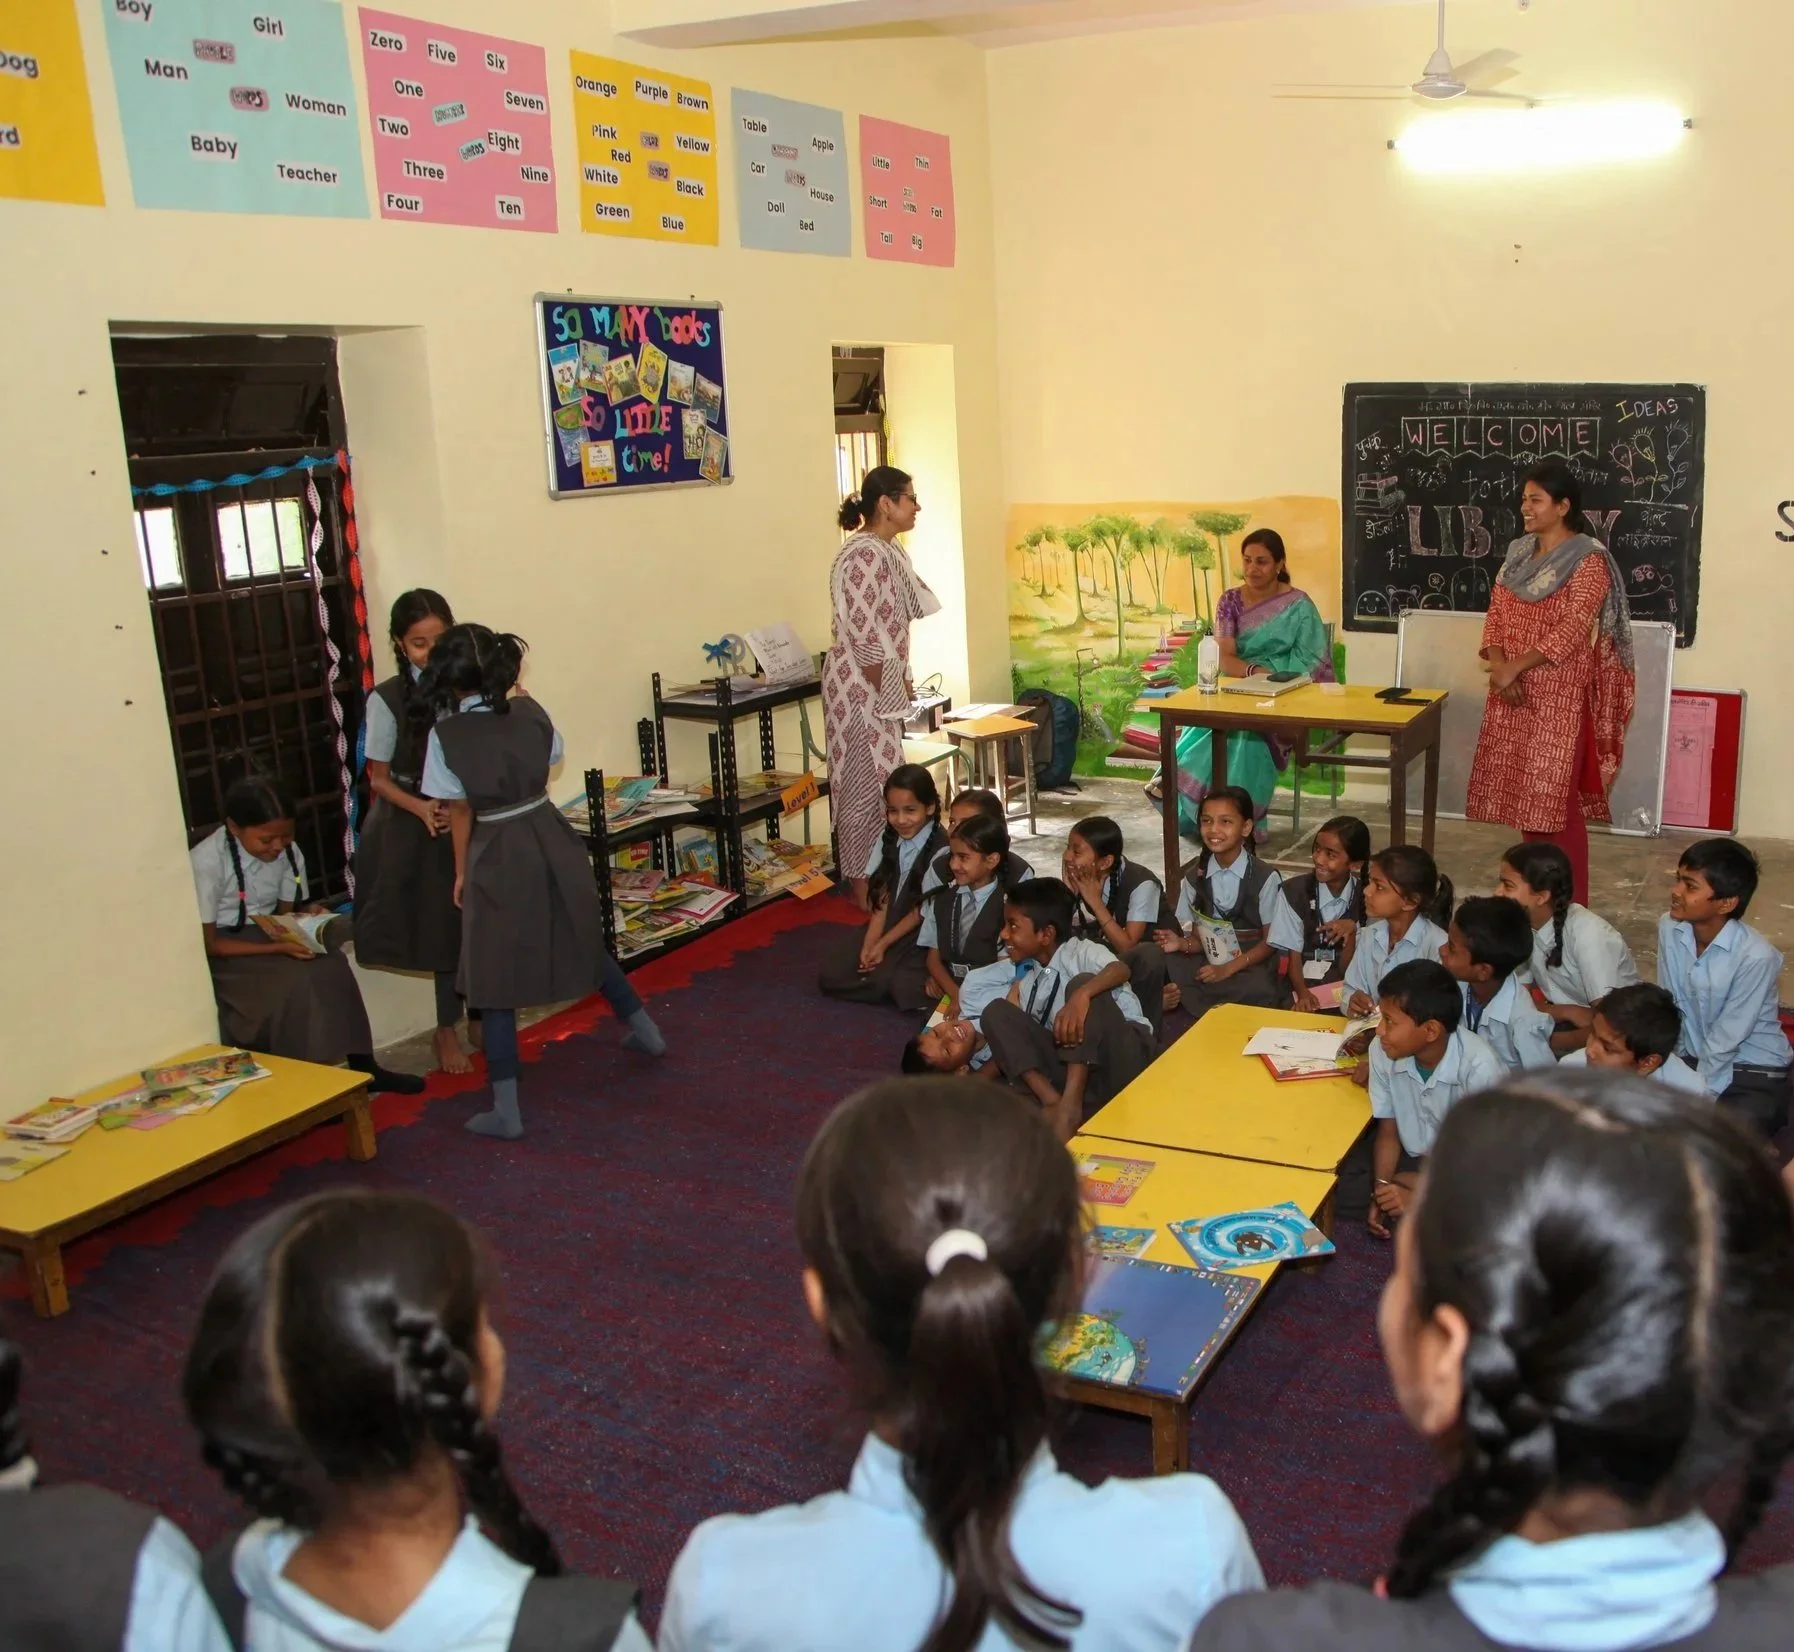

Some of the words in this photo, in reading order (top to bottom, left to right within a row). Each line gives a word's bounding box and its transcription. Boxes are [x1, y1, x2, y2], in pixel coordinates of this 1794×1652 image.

[115, 0, 152, 22] Boy
[253, 16, 283, 36] Girl
[370, 31, 403, 51] Zero
[427, 43, 456, 63] Five
[486, 53, 505, 71] Six
[144, 59, 189, 80] Man
[394, 80, 424, 97] One
[575, 75, 617, 98] Orange
[635, 80, 669, 101] Purple
[285, 93, 347, 116] Woman
[505, 91, 544, 111] Seven
[677, 92, 709, 110] Brown
[378, 118, 409, 136] Two
[592, 124, 617, 140] Pink
[742, 118, 767, 133] Table
[190, 135, 238, 160] Baby
[487, 131, 520, 152] Eight
[676, 135, 710, 152] Yellow
[812, 137, 834, 153] Apple
[610, 148, 632, 163] Red
[872, 156, 890, 170] Little
[915, 157, 930, 169] Thin
[277, 164, 338, 183] Teacher
[403, 160, 445, 180] Three
[520, 166, 549, 182] Nine
[584, 167, 619, 185] White
[750, 161, 766, 174] Car
[676, 180, 704, 197] Black
[810, 188, 835, 203] House
[387, 194, 420, 211] Four
[498, 200, 521, 215] Ten
[595, 203, 630, 218] Green
[767, 201, 785, 213] Doll
[869, 195, 888, 209] Short
[931, 206, 943, 219] Fat
[662, 216, 684, 231] Blue
[799, 219, 815, 231] Bed
[880, 232, 893, 244] Tall
[911, 235, 923, 250] Big
[589, 304, 651, 348] MANY
[653, 306, 712, 347] books
[1615, 398, 1679, 423] IDEAS
[614, 402, 673, 439] LITTLE
[1405, 420, 1592, 446] WELCOME
[622, 443, 672, 473] time!
[786, 786, 810, 811] Level
